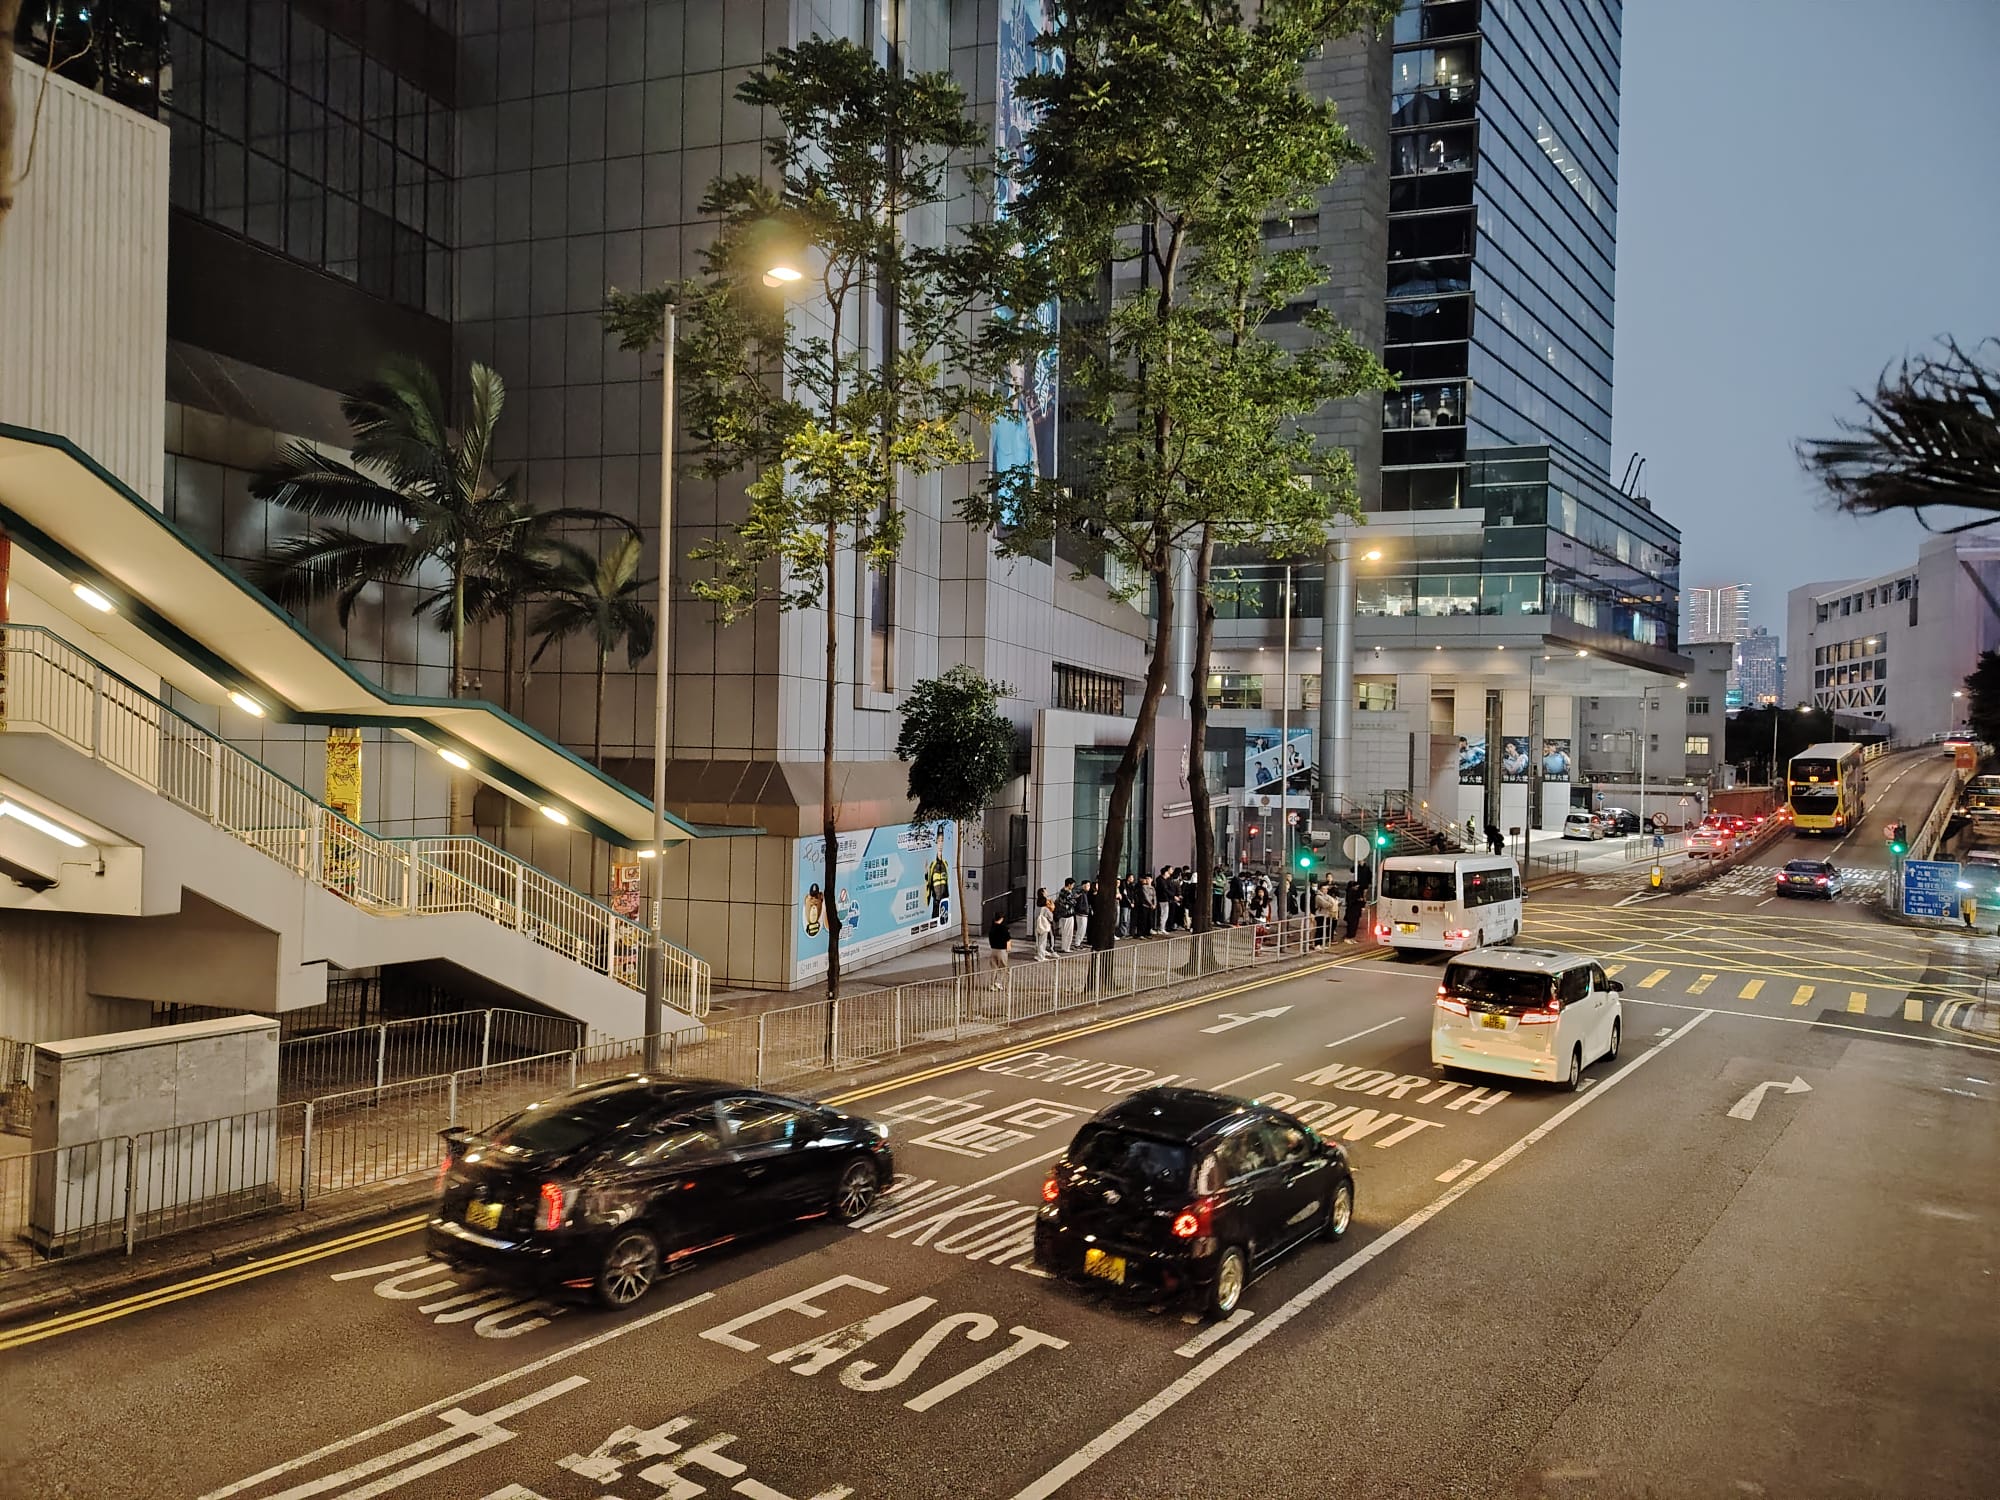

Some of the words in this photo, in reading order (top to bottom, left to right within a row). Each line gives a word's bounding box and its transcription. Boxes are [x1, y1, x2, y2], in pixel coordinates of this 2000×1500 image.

[876, 1089, 1098, 1158] 中區
[1292, 1063, 1512, 1115] NORTH
[698, 1274, 1070, 1413] EAST
